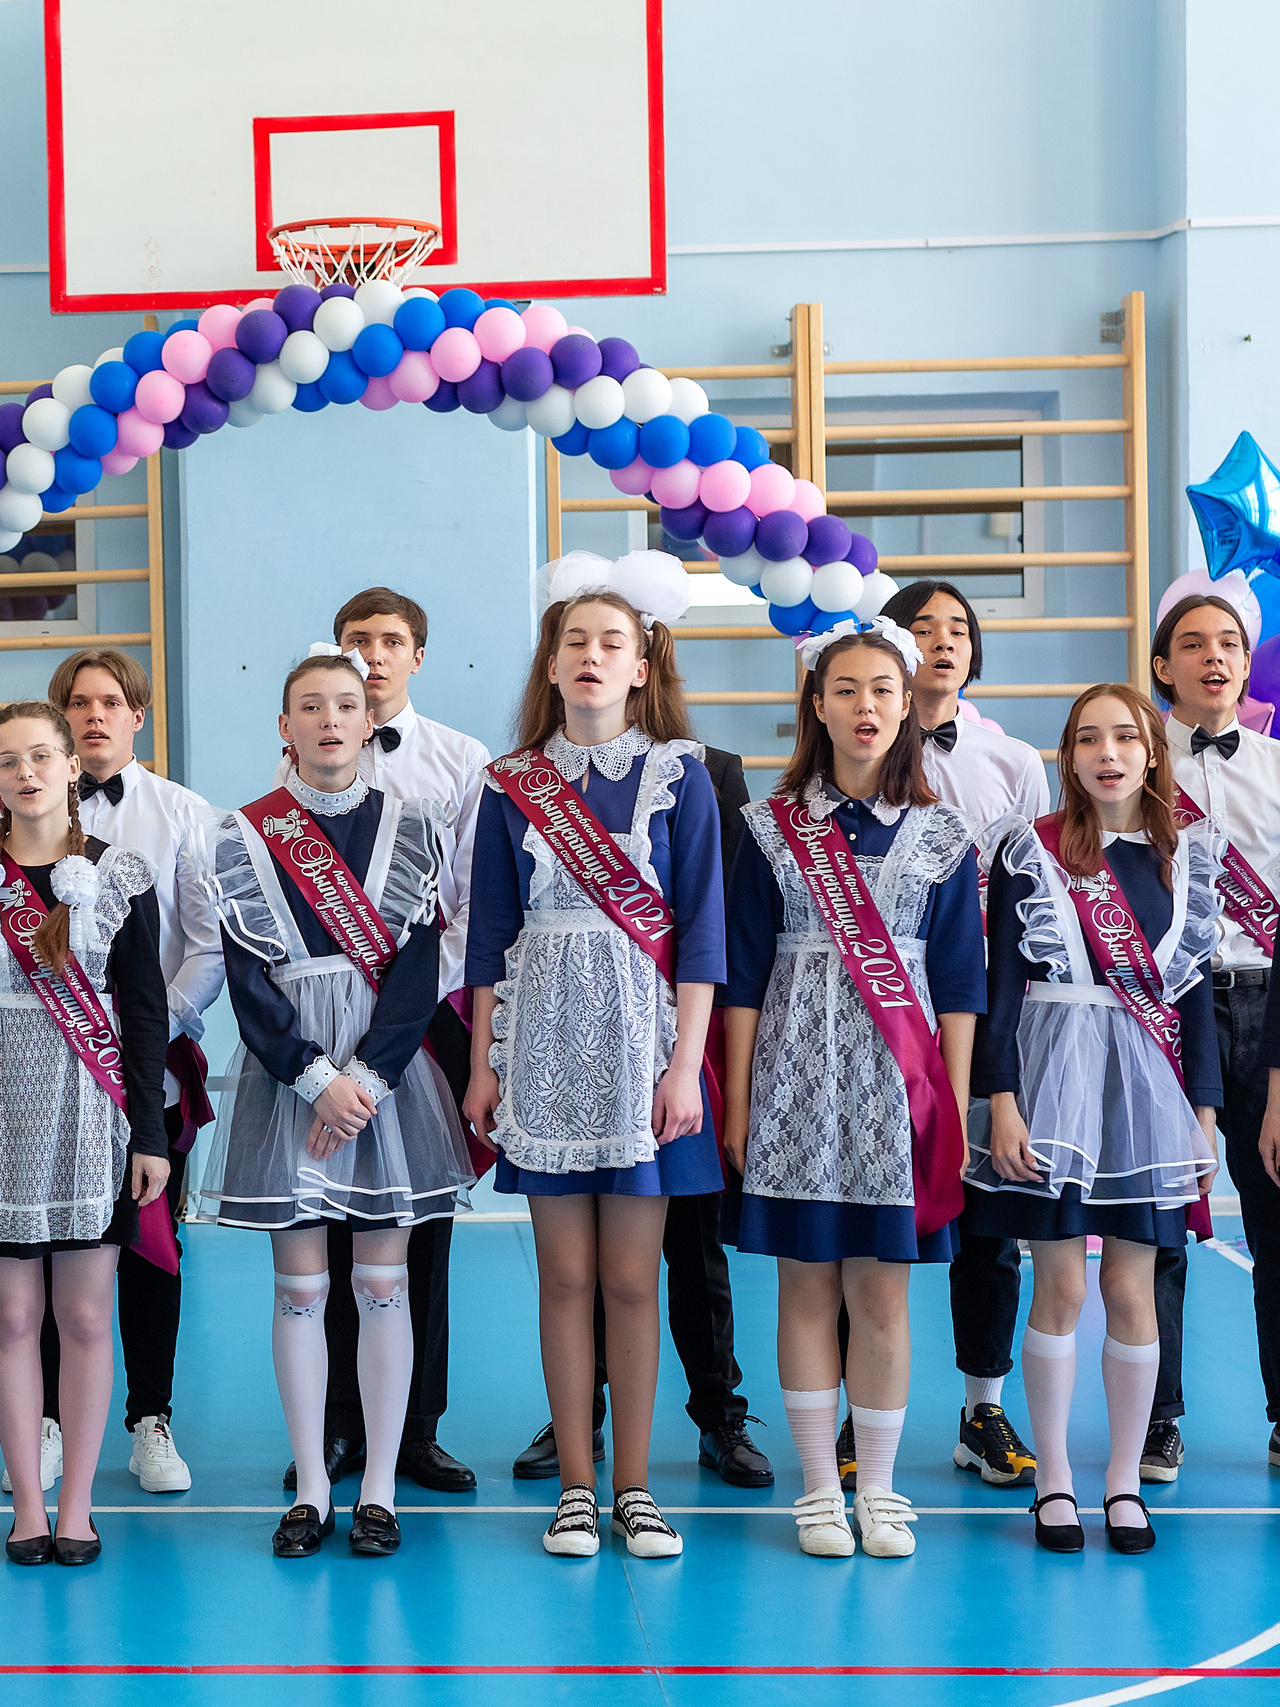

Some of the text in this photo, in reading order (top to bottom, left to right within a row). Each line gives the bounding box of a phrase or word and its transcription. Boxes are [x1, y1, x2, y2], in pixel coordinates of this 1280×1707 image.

[519, 767, 674, 942] Выпускница 2021
[548, 834, 564, 850] МБОУ
[560, 849, 575, 864] СОШ
[583, 880, 606, 904] 11класс
[564, 798, 624, 872] Коробкова Арина
[290, 836, 381, 965] Выпускница
[332, 870, 360, 904] Ларина
[354, 904, 391, 955] Анастасия
[789, 805, 914, 1009] Выпускница 2021
[834, 850, 865, 906] Сим Ирина
[1226, 855, 1266, 899] Константин
[319, 909, 336, 927] МБОУ
[330, 925, 344, 941] СОШ
[807, 876, 822, 896] МБОУ
[817, 893, 828, 910] СОШ
[831, 926, 849, 956] 11класс
[1240, 915, 1260, 936] 11класс
[1091, 901, 1166, 1026] Выпускница
[1130, 940, 1152, 980] Козлова
[33, 979, 50, 998] МБОУ
[45, 995, 58, 1012] СОШ
[67, 1028, 86, 1054] 11класс
[78, 990, 105, 1028] Наталья
[84, 1029, 128, 1095] 202
